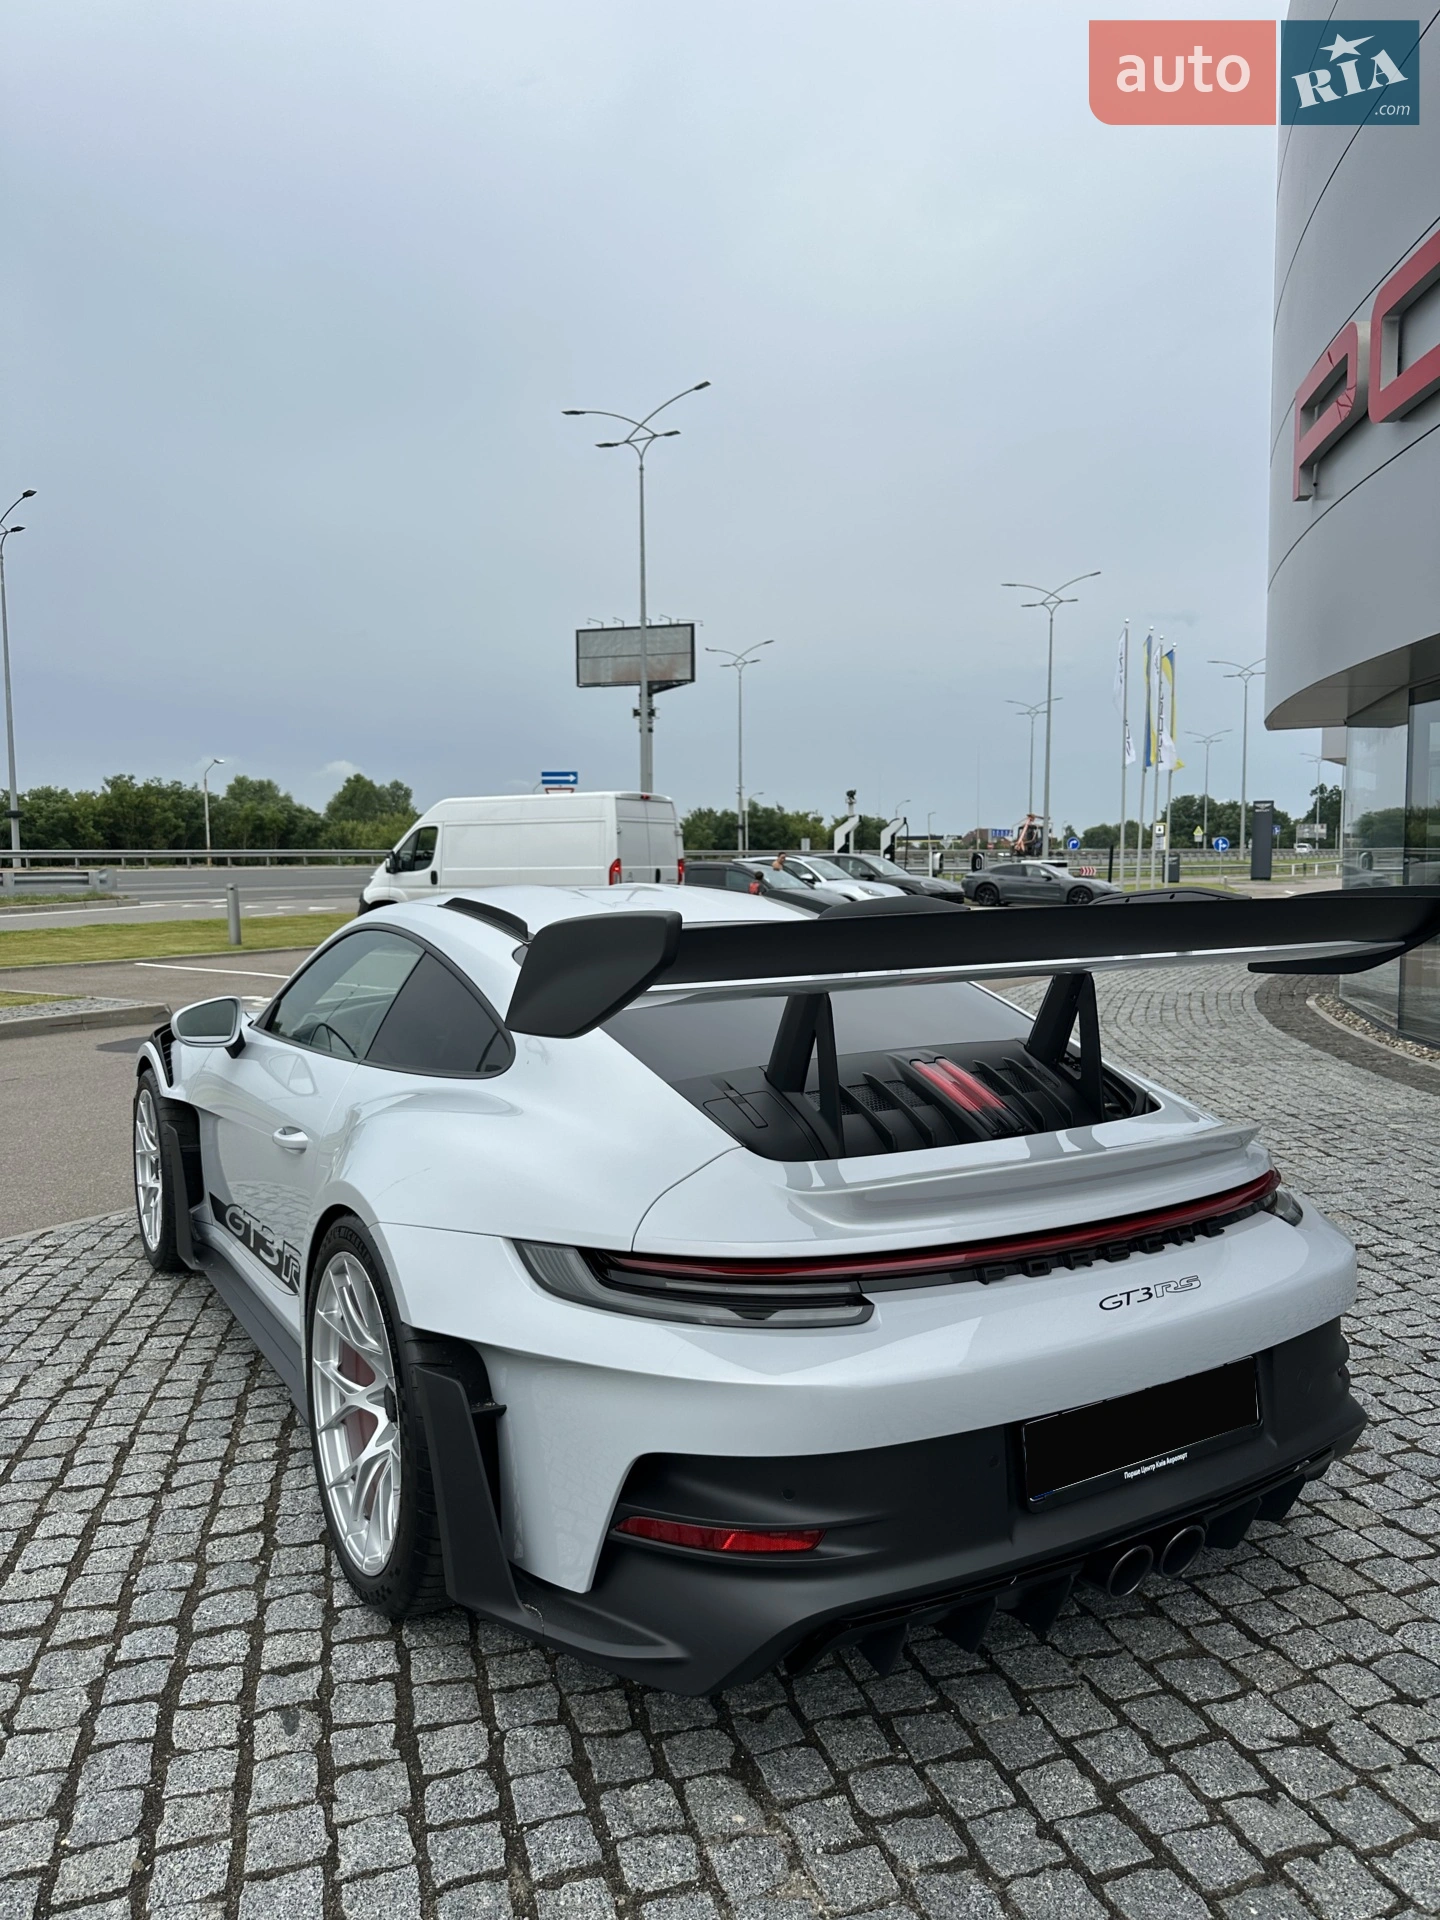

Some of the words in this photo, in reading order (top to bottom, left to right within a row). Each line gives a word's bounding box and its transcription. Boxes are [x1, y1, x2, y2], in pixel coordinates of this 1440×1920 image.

[982, 1218, 1225, 1286] PORSCHE
[1124, 1469, 1140, 1479] Порше
[1141, 1464, 1155, 1474] Центр
[1155, 1459, 1166, 1468] Київ
[1166, 1452, 1187, 1464] Аеропорт
